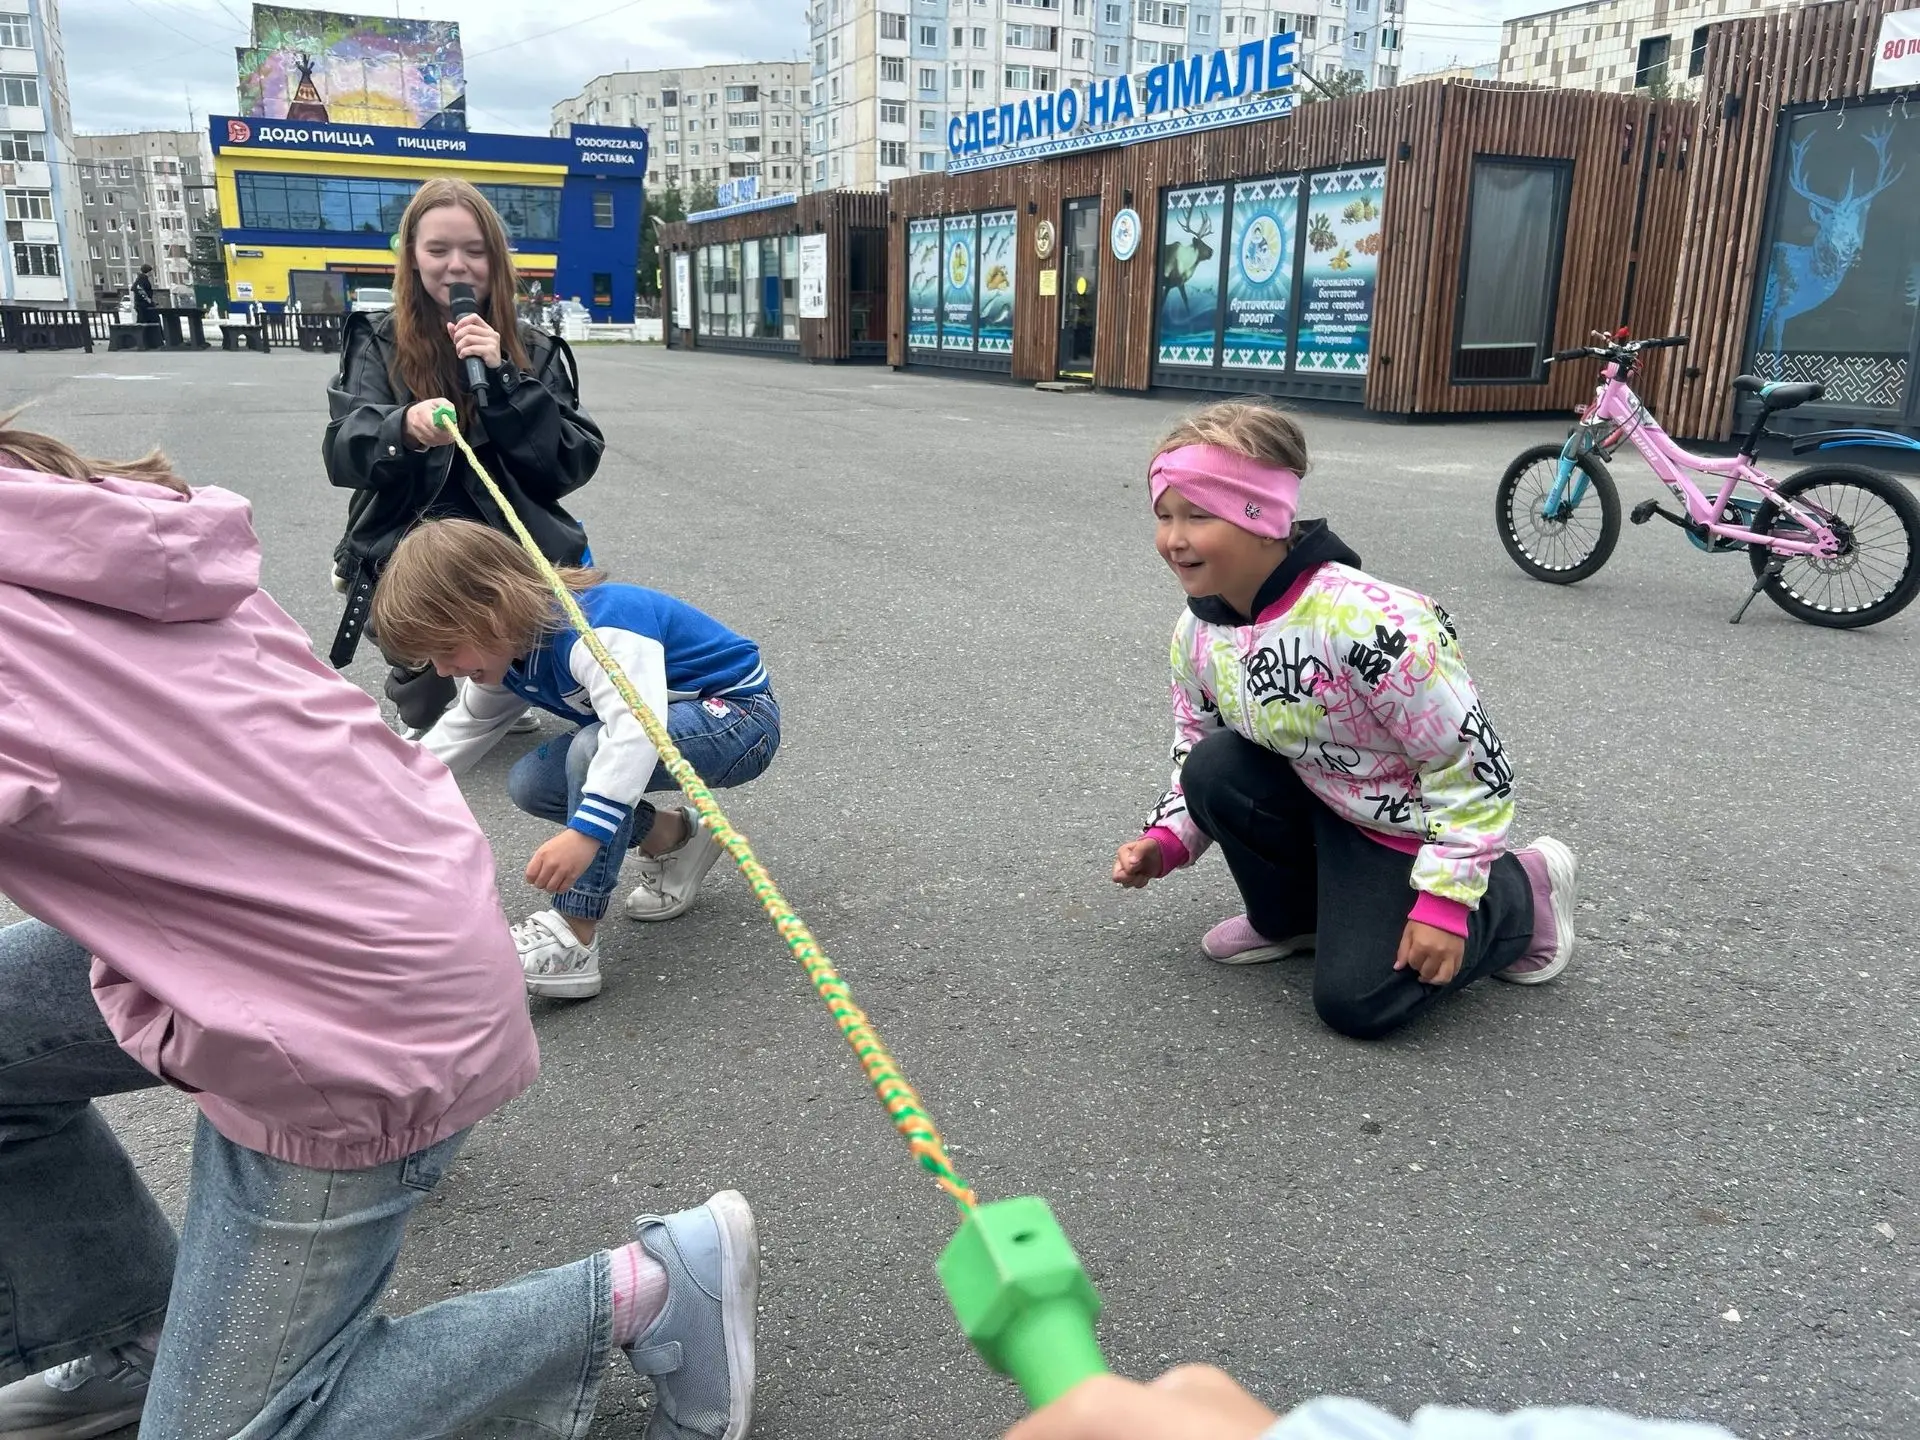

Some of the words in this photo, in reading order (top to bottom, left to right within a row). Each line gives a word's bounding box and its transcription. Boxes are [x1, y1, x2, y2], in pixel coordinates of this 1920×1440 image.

[1882, 38, 1905, 60] 80
[948, 88, 1079, 154] СДЕЛАНО
[1089, 74, 1136, 126] НА
[1146, 31, 1297, 115] ЯМАЛЕ
[259, 127, 309, 142] ДОДО
[312, 130, 375, 147] ПИЦЦА
[397, 136, 467, 151] ПИЦЦЕРИЯ
[575, 137, 643, 150] DODOPIZZA.RU
[581, 151, 635, 165] ДОСТАВКА
[1229, 297, 1287, 313] Арктический
[1238, 313, 1275, 326] продукт
